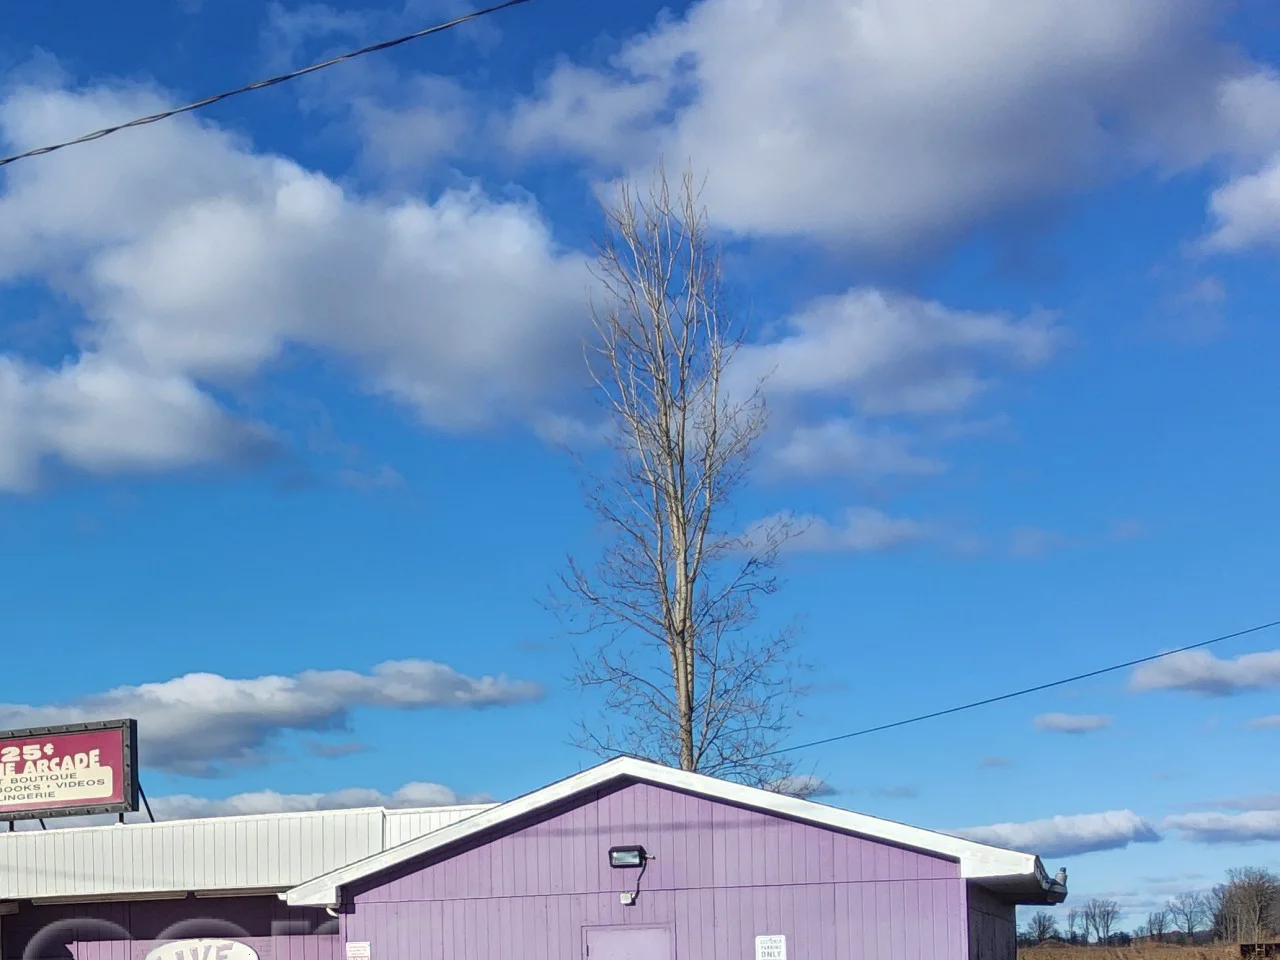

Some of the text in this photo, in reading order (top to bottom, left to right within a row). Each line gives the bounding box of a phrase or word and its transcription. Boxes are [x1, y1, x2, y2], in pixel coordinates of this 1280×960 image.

[23, 749, 100, 775] ARCADE
[10, 772, 77, 785] BOUTIQUE
[56, 778, 105, 789] VIDEOS
[761, 950, 782, 958] ONLY
